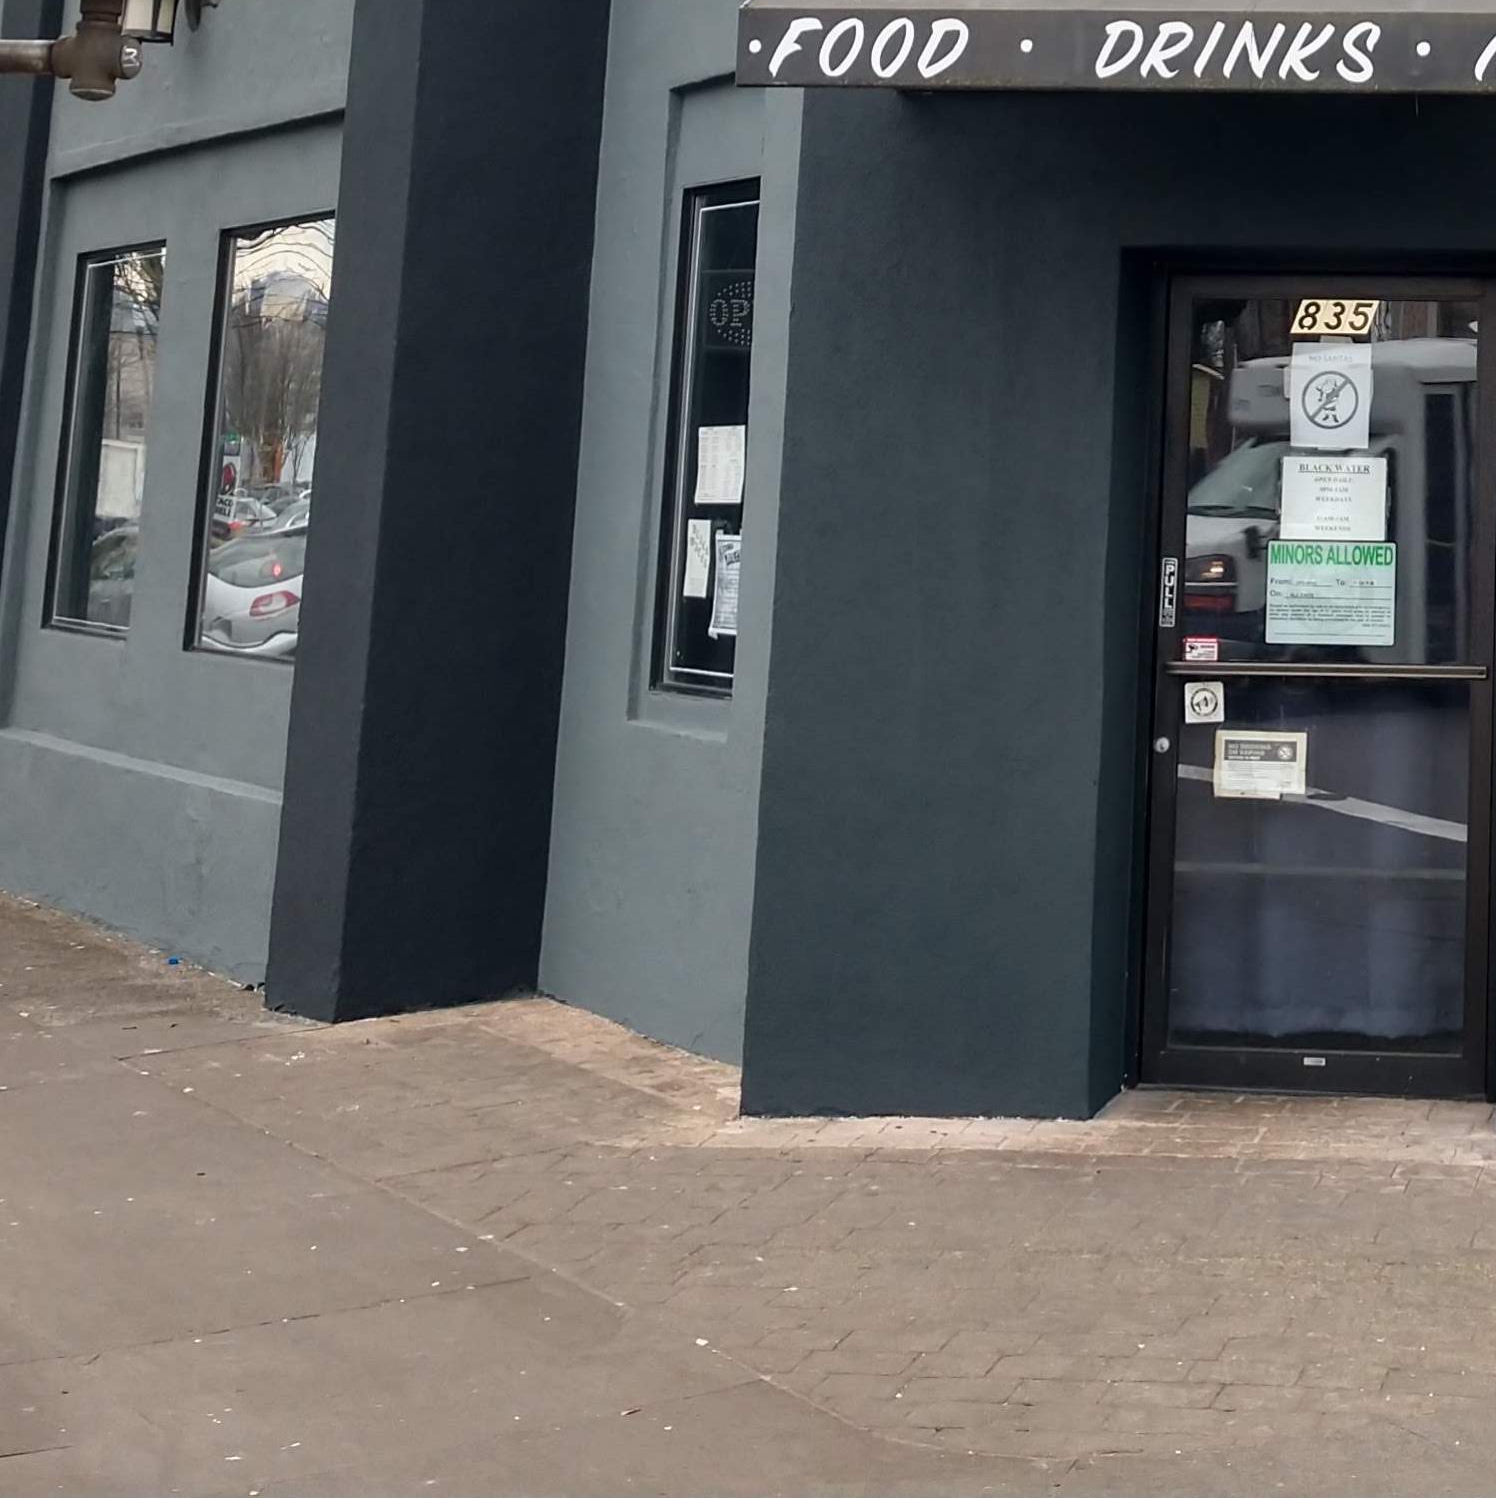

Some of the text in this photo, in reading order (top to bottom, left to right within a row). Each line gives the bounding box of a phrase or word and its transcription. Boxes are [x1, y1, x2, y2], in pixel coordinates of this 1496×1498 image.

[768, 17, 969, 80] FOOD
[1095, 20, 1381, 83] DRINKS
[709, 299, 750, 327] OP
[1298, 301, 1374, 331] 835
[1270, 544, 1393, 566] MINORS ALLOWED
[1164, 563, 1175, 608] PULL
